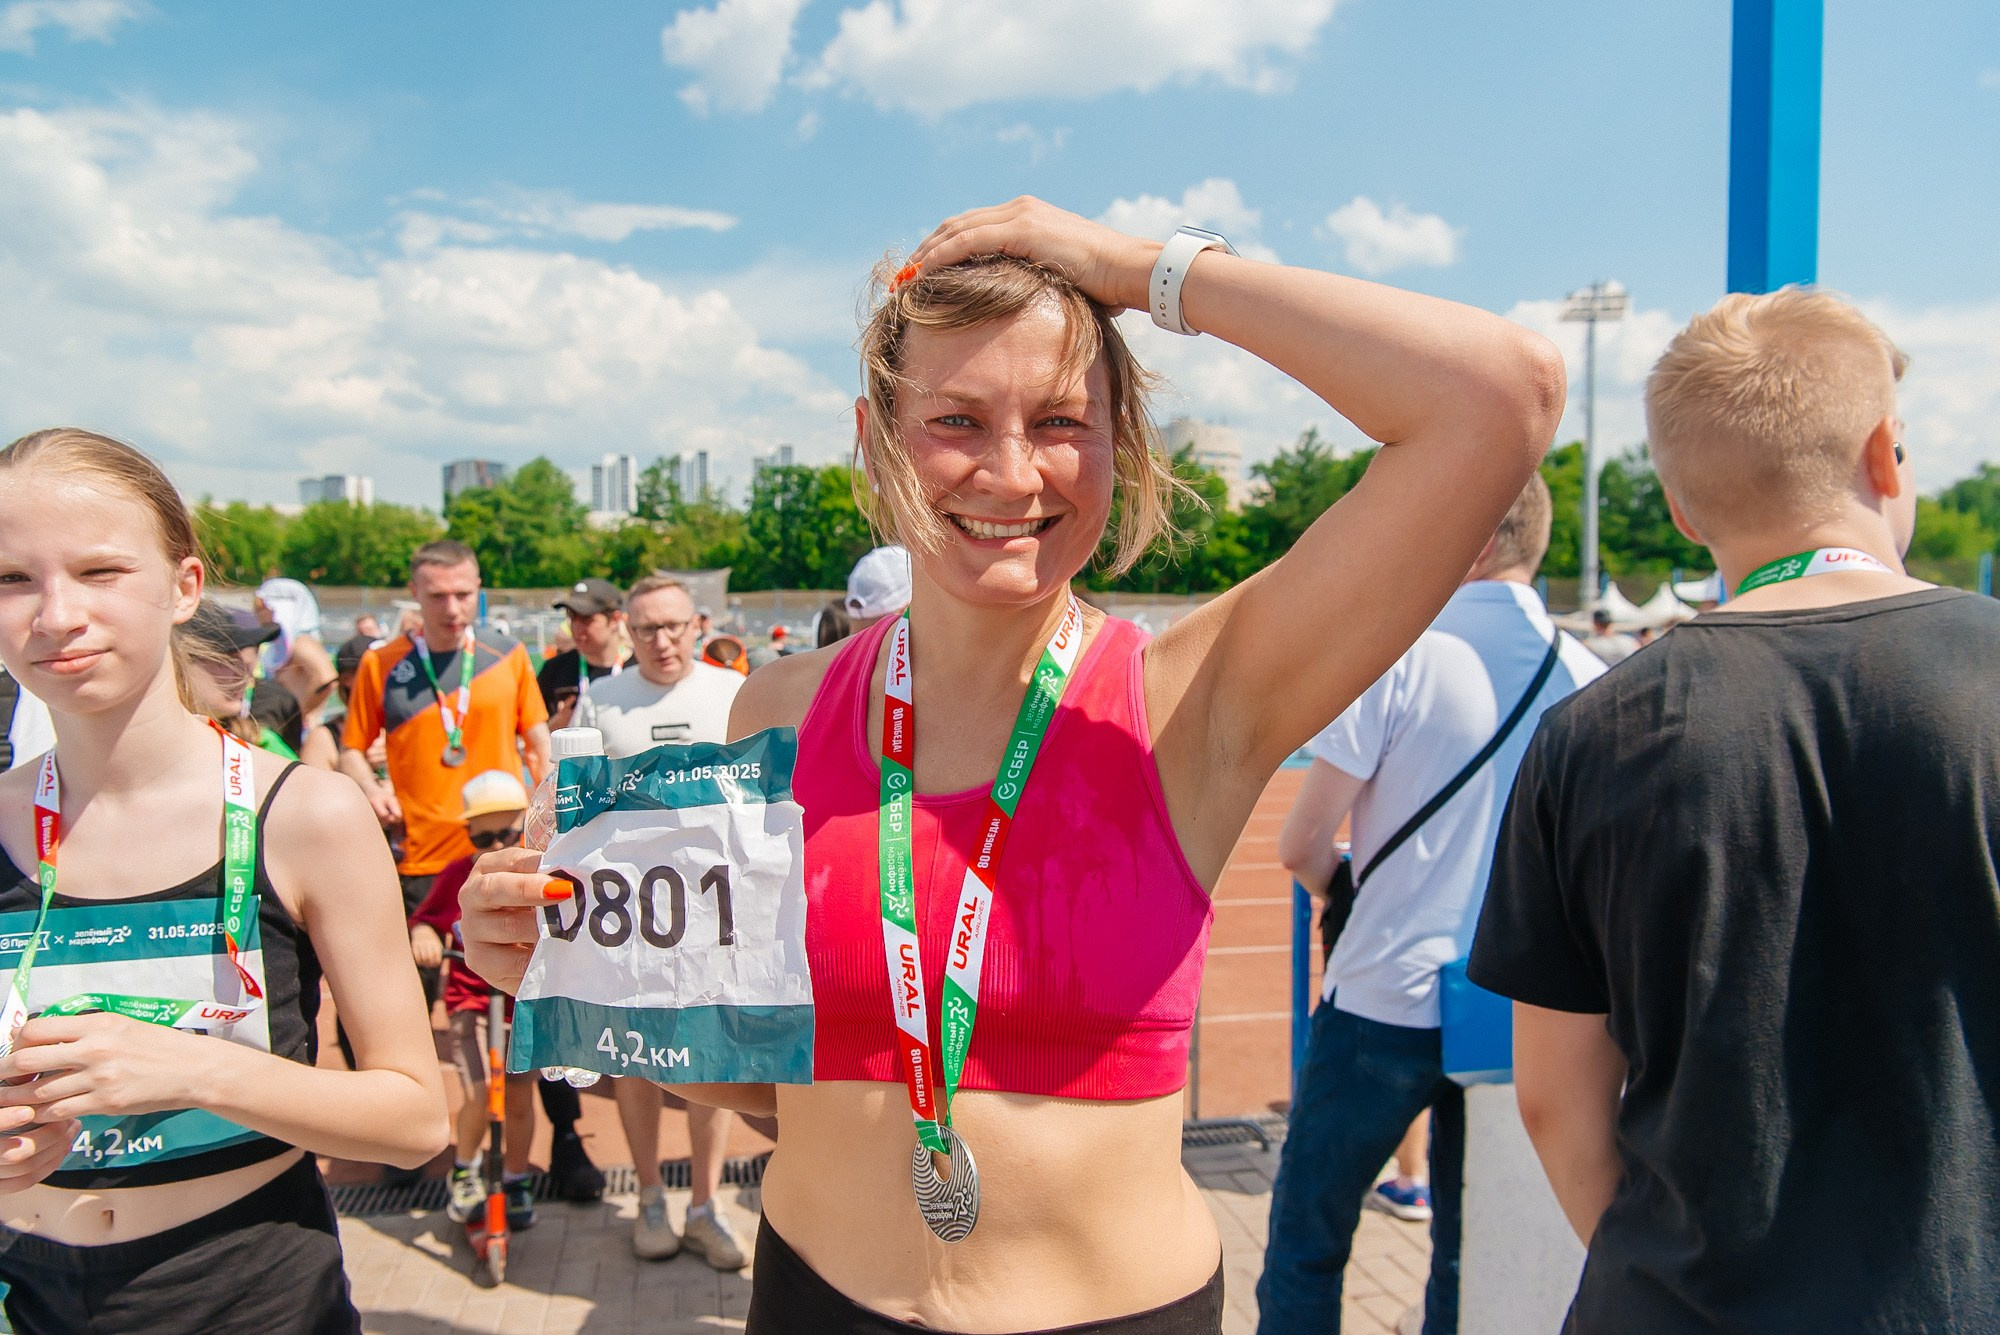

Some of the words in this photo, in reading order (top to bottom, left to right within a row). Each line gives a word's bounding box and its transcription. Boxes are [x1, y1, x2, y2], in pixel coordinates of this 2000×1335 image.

[895, 627, 907, 686] URAL
[892, 707, 904, 720] 80
[1026, 686, 1045, 722] зелёный
[1032, 690, 1051, 729] марафон
[892, 720, 903, 753] ПОБЕДА!
[230, 752, 241, 796] URAL
[1007, 739, 1029, 779] СБЕР
[889, 792, 904, 833] СБЕР
[982, 818, 1001, 854] ПОБЕДА!
[887, 846, 898, 892] марафон
[896, 848, 908, 895] зелёный
[977, 854, 990, 869] 80
[230, 876, 245, 914] СБЕР
[543, 864, 734, 948] 0801
[75, 927, 113, 938] зелёный
[148, 922, 225, 940] 31.05.2025
[953, 895, 978, 970] URAL
[975, 899, 985, 939] AIRLINES
[69, 936, 109, 946] марафон
[896, 977, 907, 1017] AIRLINES
[899, 944, 921, 1019] URAL
[910, 1048, 922, 1065] 80
[947, 1022, 957, 1070] зелёный
[954, 1026, 966, 1077] марафон
[911, 1066, 927, 1108] ПОБЕДА!
